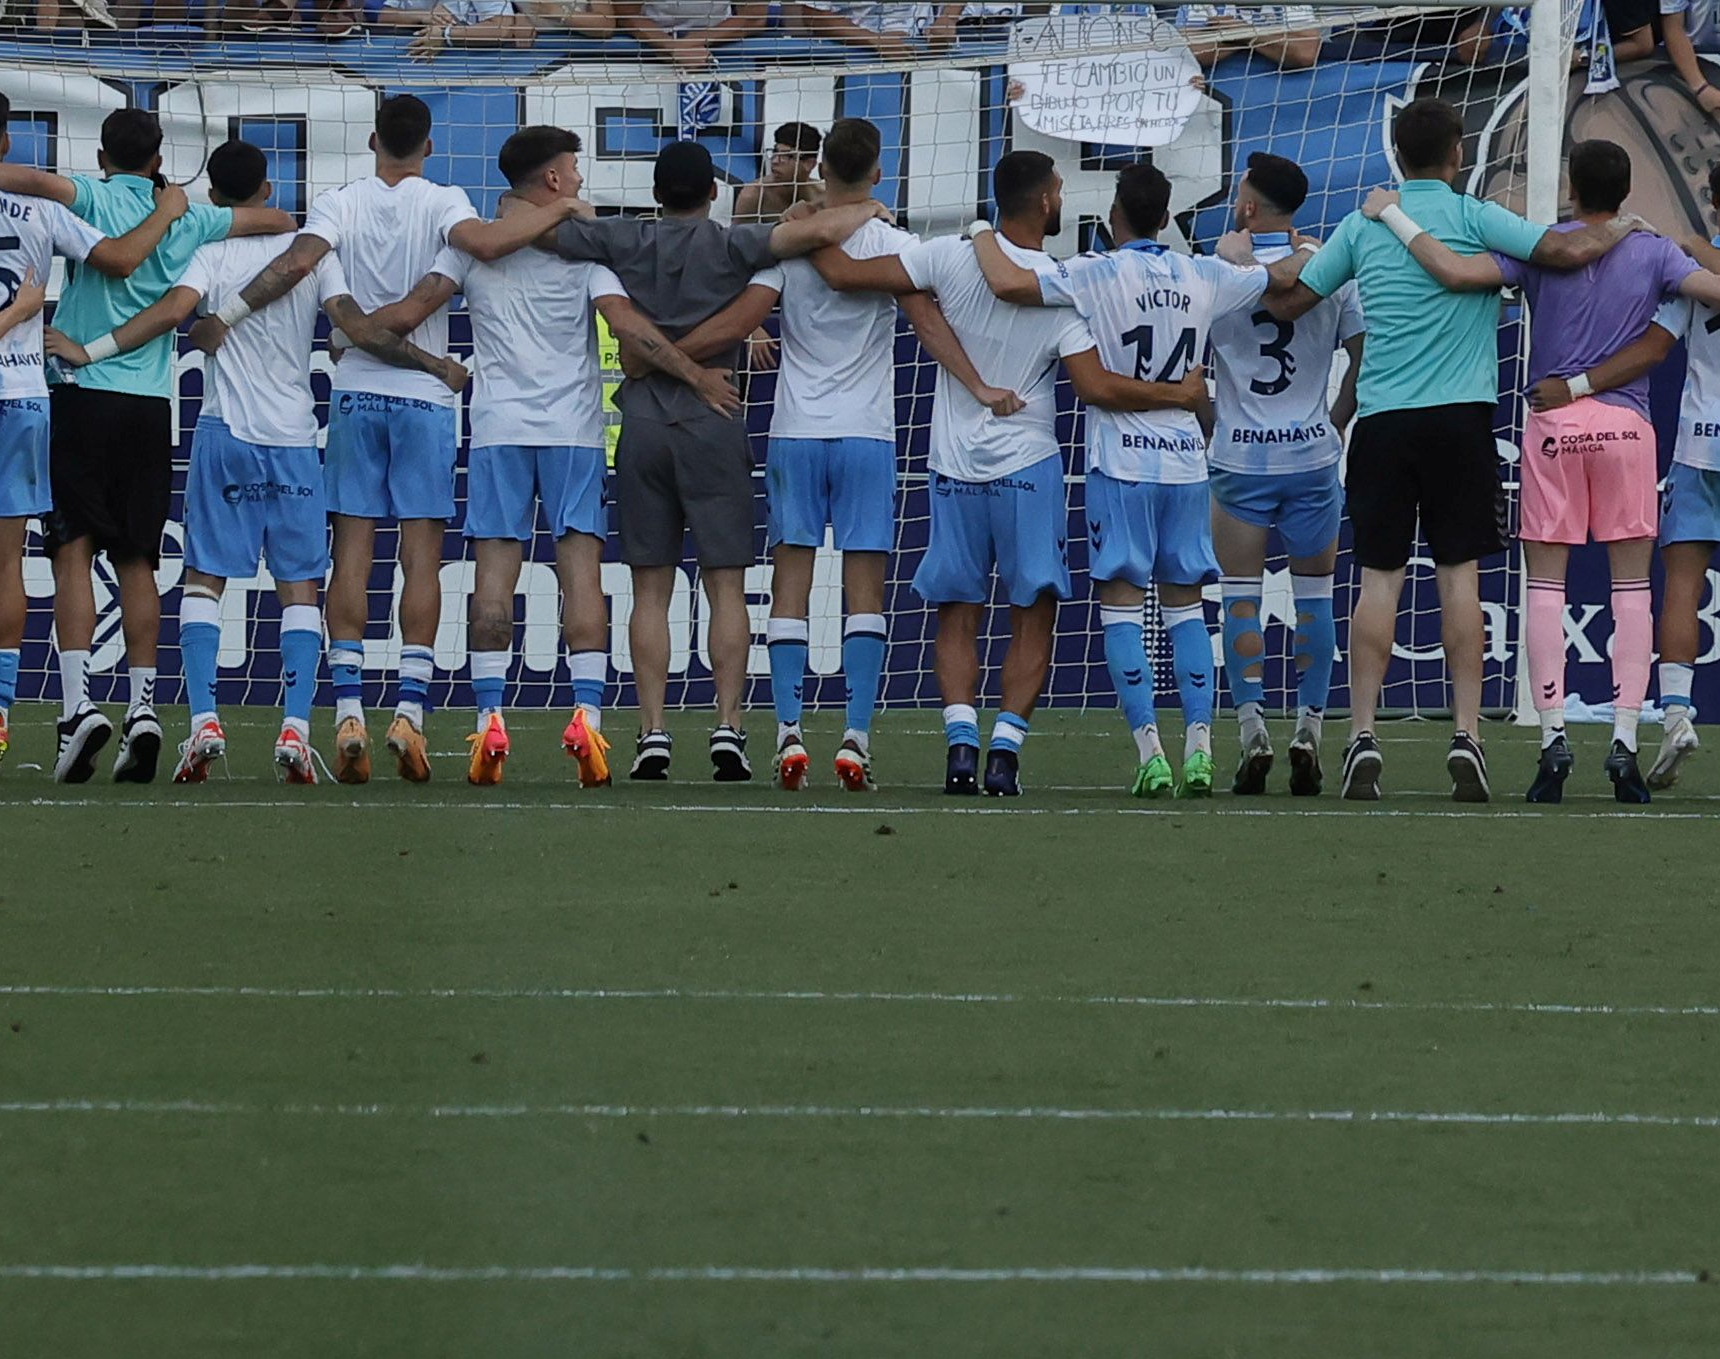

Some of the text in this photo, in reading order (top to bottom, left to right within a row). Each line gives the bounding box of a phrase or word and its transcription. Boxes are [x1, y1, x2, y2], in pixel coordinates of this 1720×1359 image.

[1072, 61, 1147, 88] CAMBIO
[1154, 65, 1175, 82] UN
[1100, 90, 1144, 113] POR
[1151, 91, 1179, 113] TU
[1121, 324, 1199, 384] 14
[1249, 303, 1297, 397] 3
[1231, 426, 1327, 444] BENAHAVIS
[1597, 430, 1641, 443] DEL SOL
